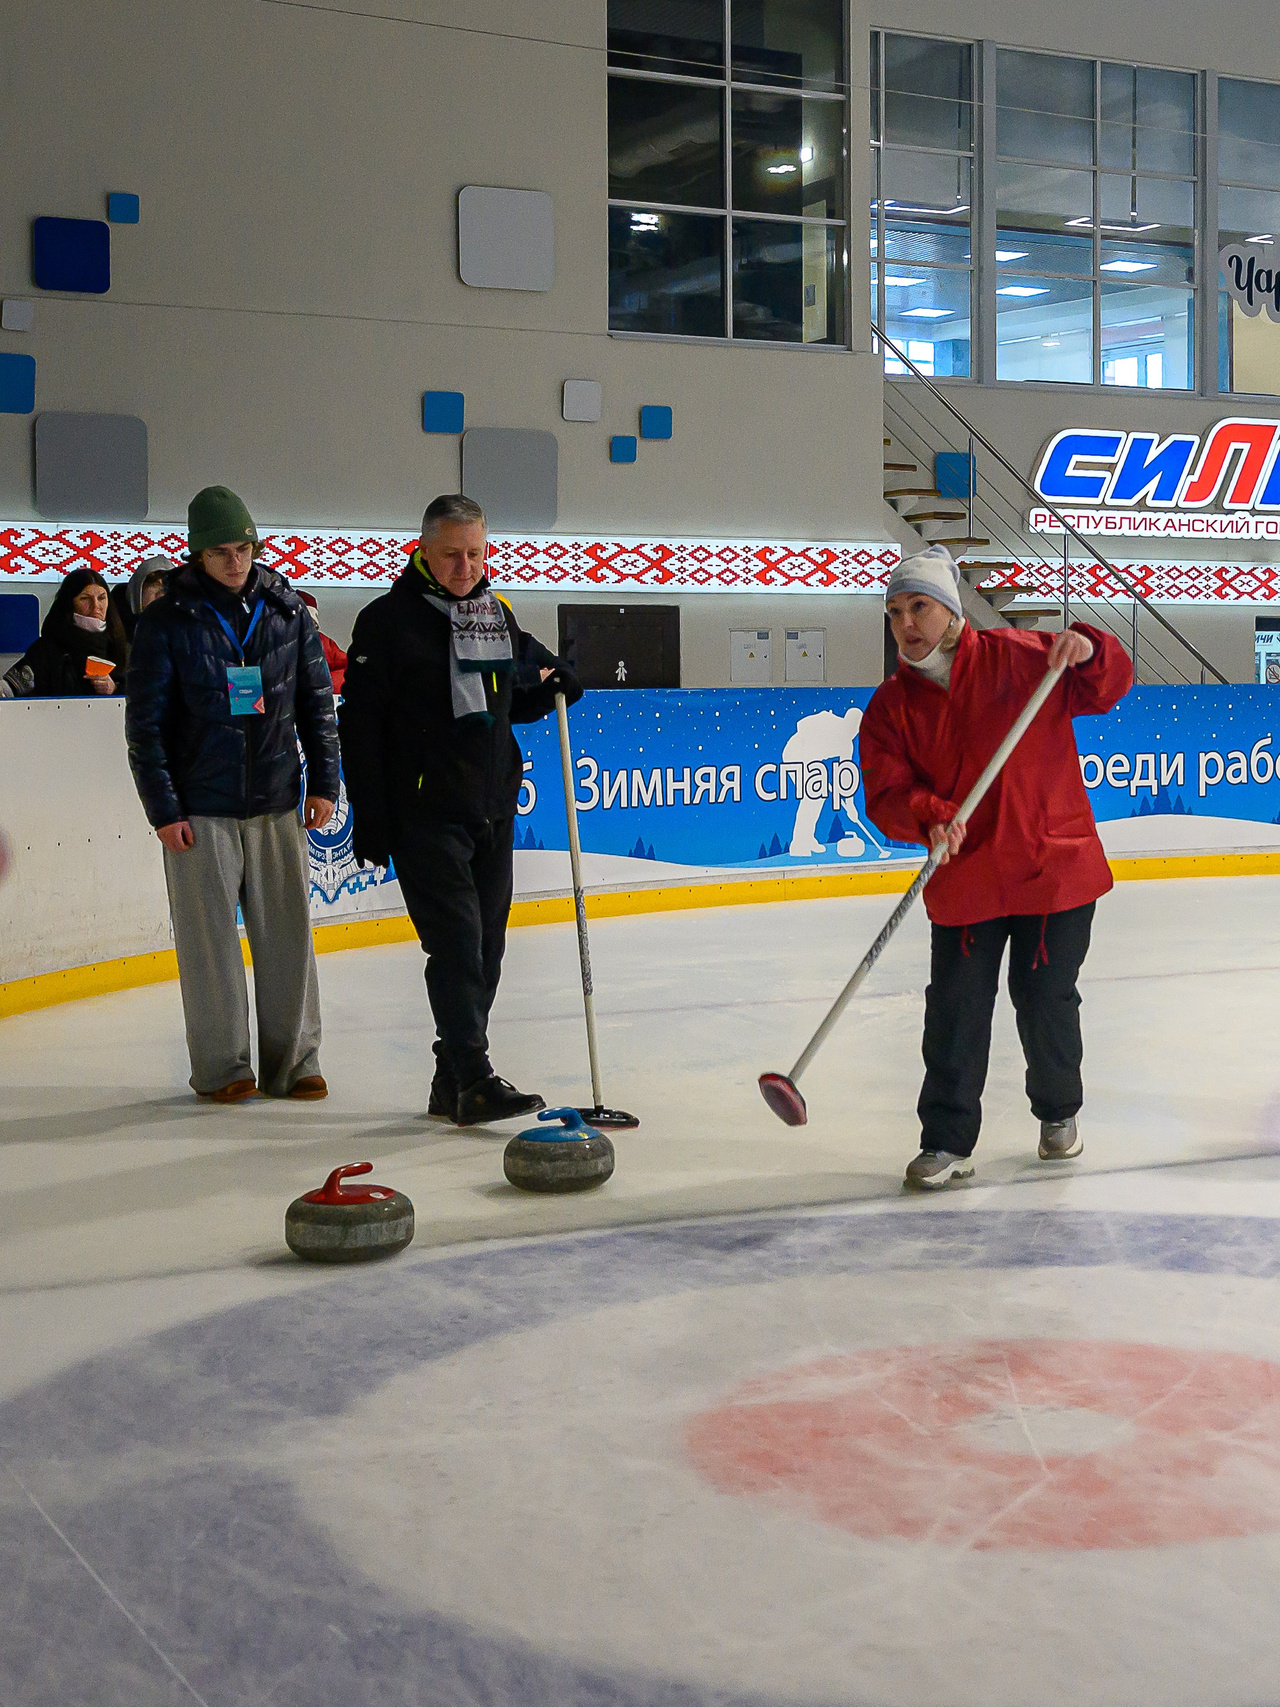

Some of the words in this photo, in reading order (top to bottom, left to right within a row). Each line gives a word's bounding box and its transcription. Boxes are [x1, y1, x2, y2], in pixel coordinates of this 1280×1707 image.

[1034, 513, 1249, 534] РЕСПУБЛИКАНСКИЙ
[575, 756, 742, 811] Зимняя
[754, 759, 860, 811] спар
[1078, 752, 1185, 797] реди
